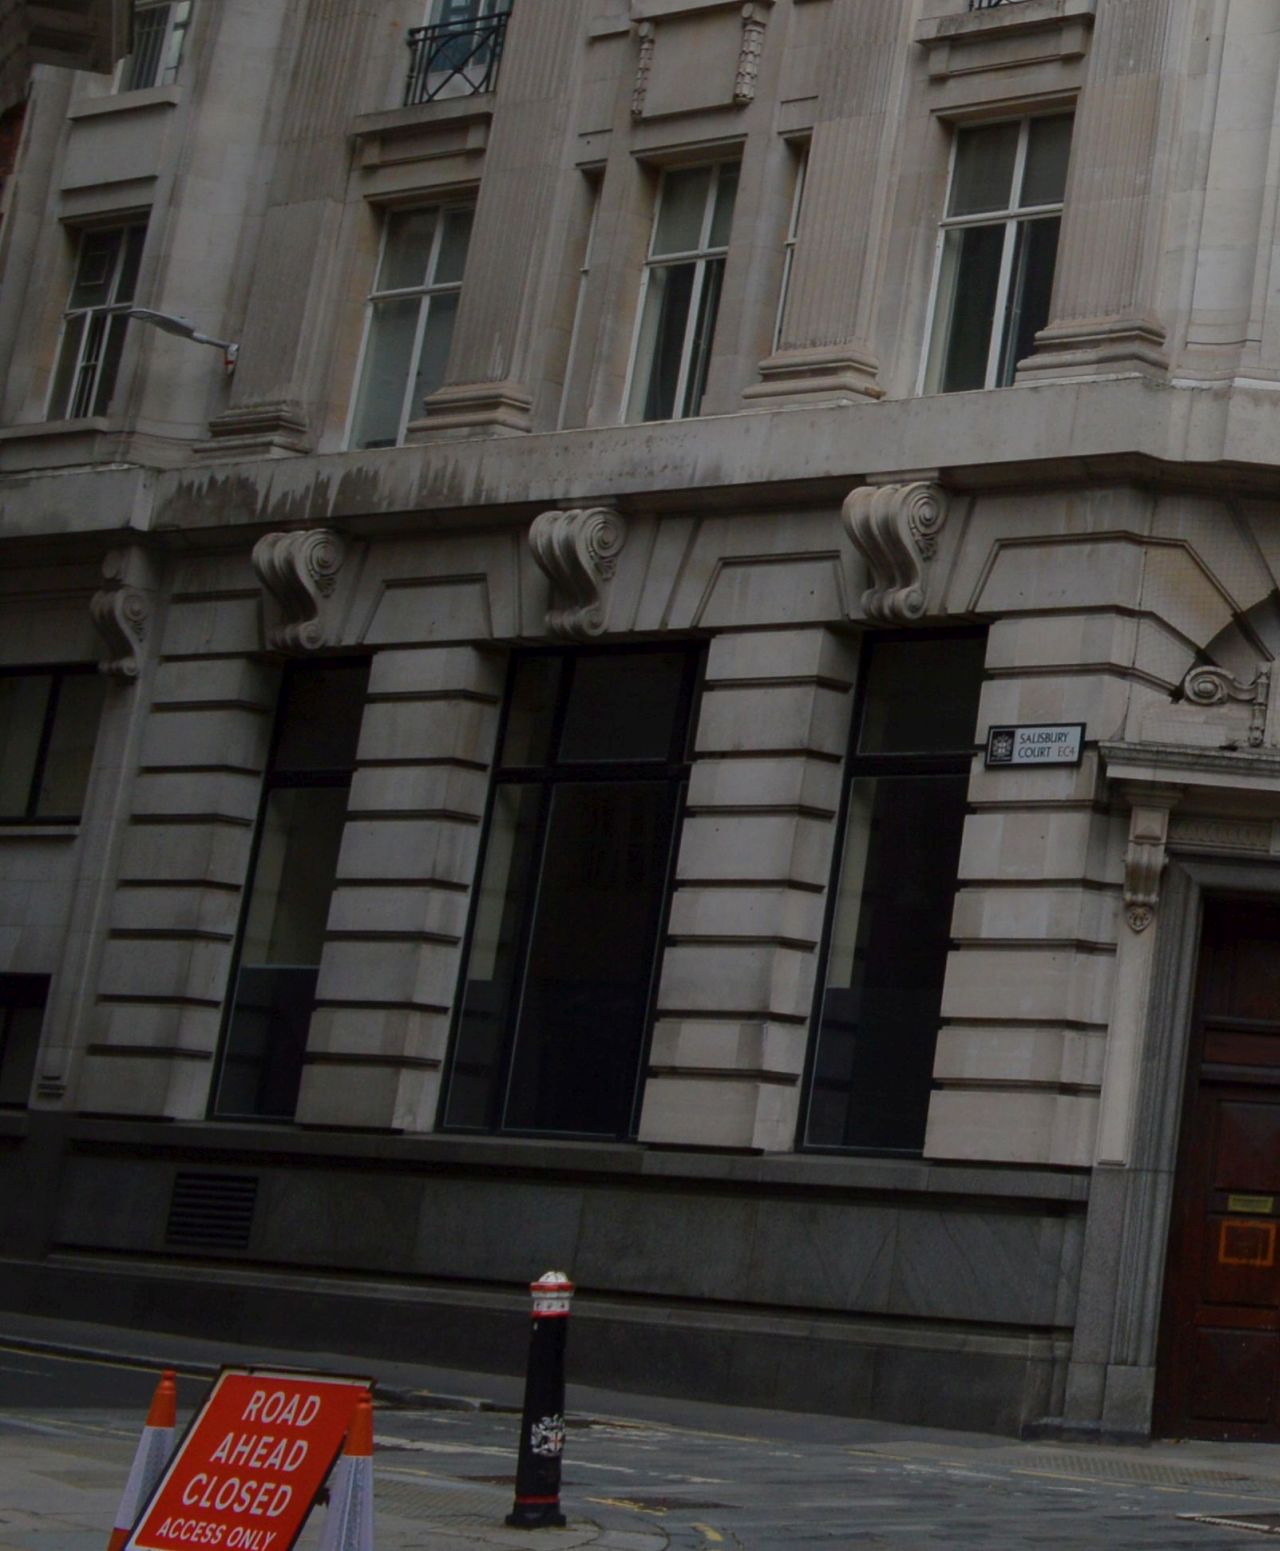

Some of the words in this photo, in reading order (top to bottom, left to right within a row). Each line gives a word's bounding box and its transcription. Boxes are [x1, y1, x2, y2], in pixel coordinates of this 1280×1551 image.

[1018, 746, 1052, 759] COURT
[1057, 746, 1076, 757] EC4
[1020, 730, 1070, 744] SALISBURY
[241, 1390, 321, 1428] ROAD
[209, 1431, 309, 1472] AHEAD
[182, 1473, 292, 1517] CLOSED
[156, 1516, 225, 1545] ACCESS
[227, 1527, 277, 1551] ONLY
